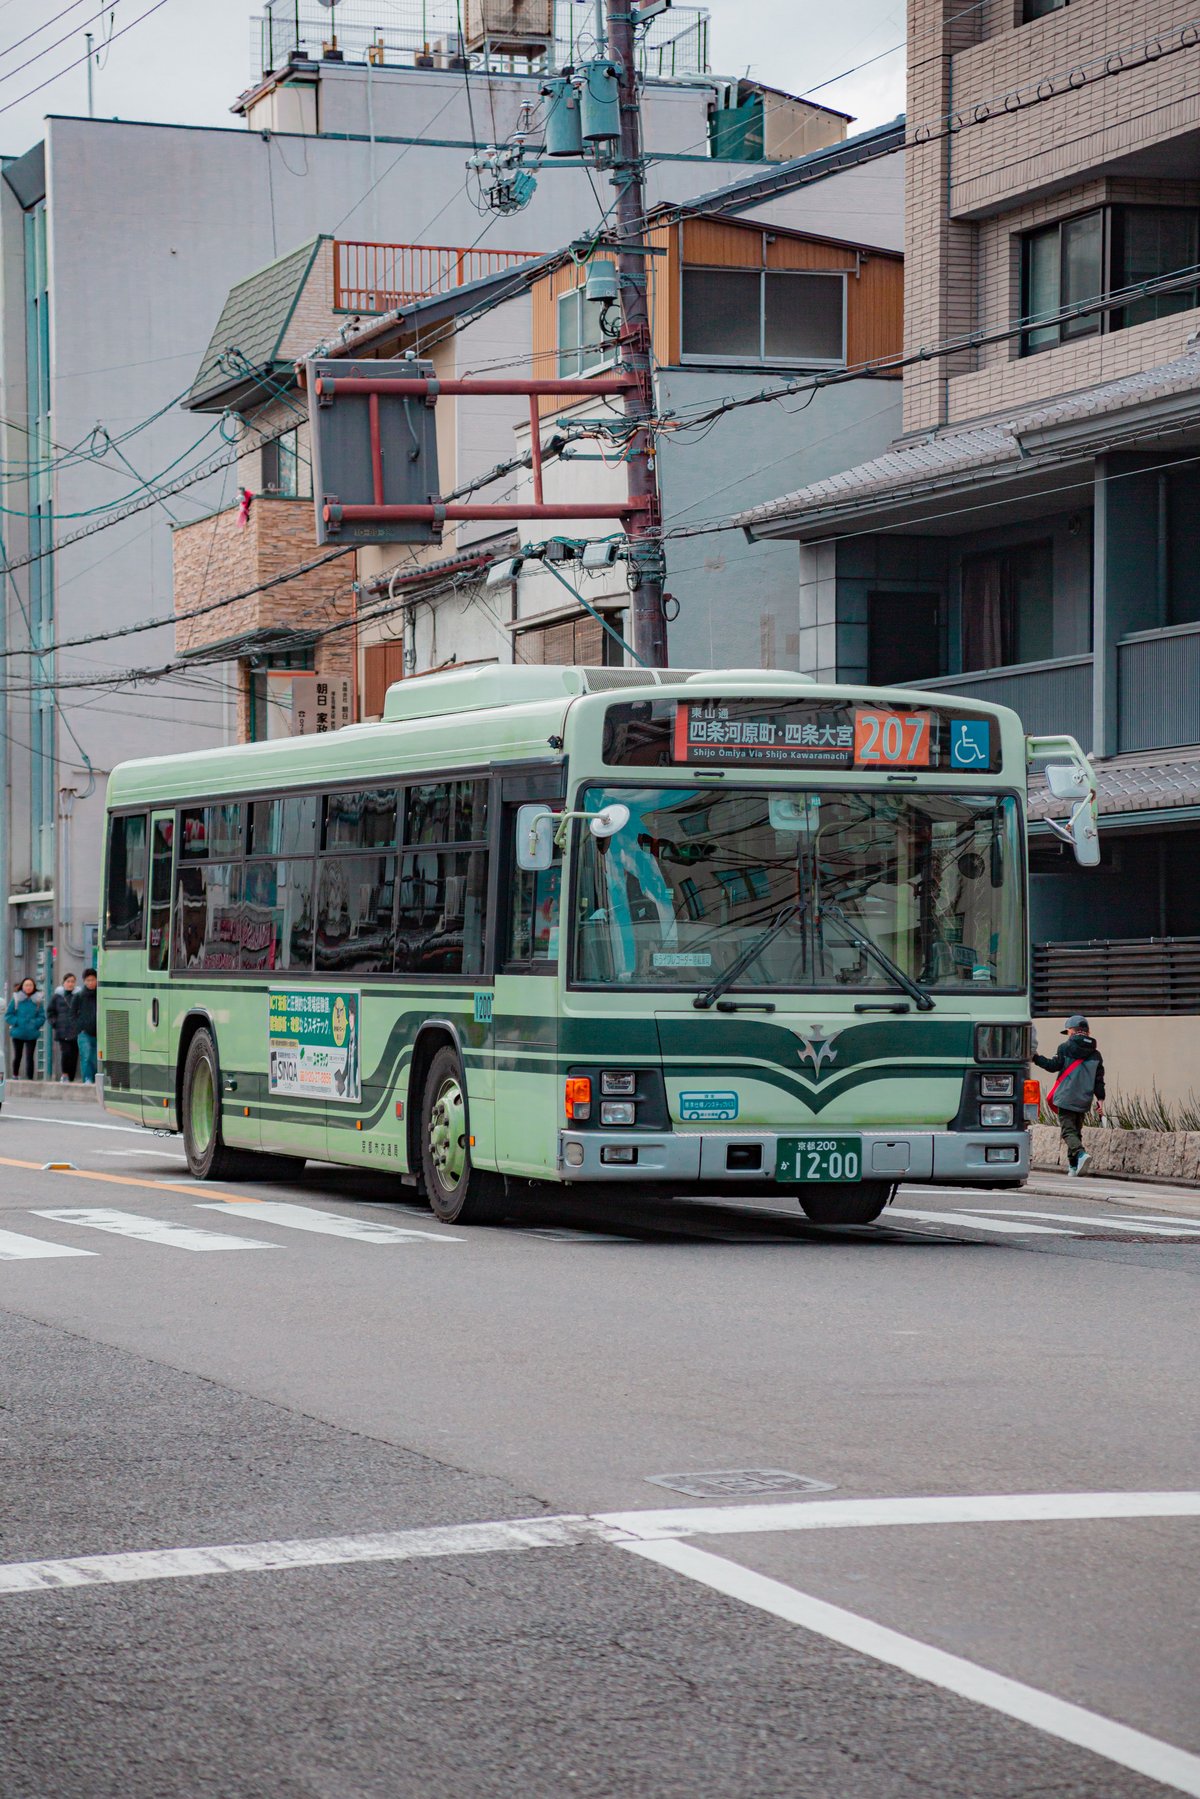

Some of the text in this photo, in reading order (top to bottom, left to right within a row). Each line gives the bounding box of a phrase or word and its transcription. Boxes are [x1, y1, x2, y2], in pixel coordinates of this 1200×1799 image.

[316, 683, 328, 706] 朝日
[691, 707, 729, 720] 東山通
[689, 721, 854, 747] 四条河原町・四条大宮
[860, 715, 925, 761] 207
[693, 748, 849, 760] Shijo Omiya Via Shijo Kawaramachi
[475, 995, 492, 1019] 1200
[797, 1141, 837, 1151] 京都200
[780, 1152, 858, 1179] か 12-00
